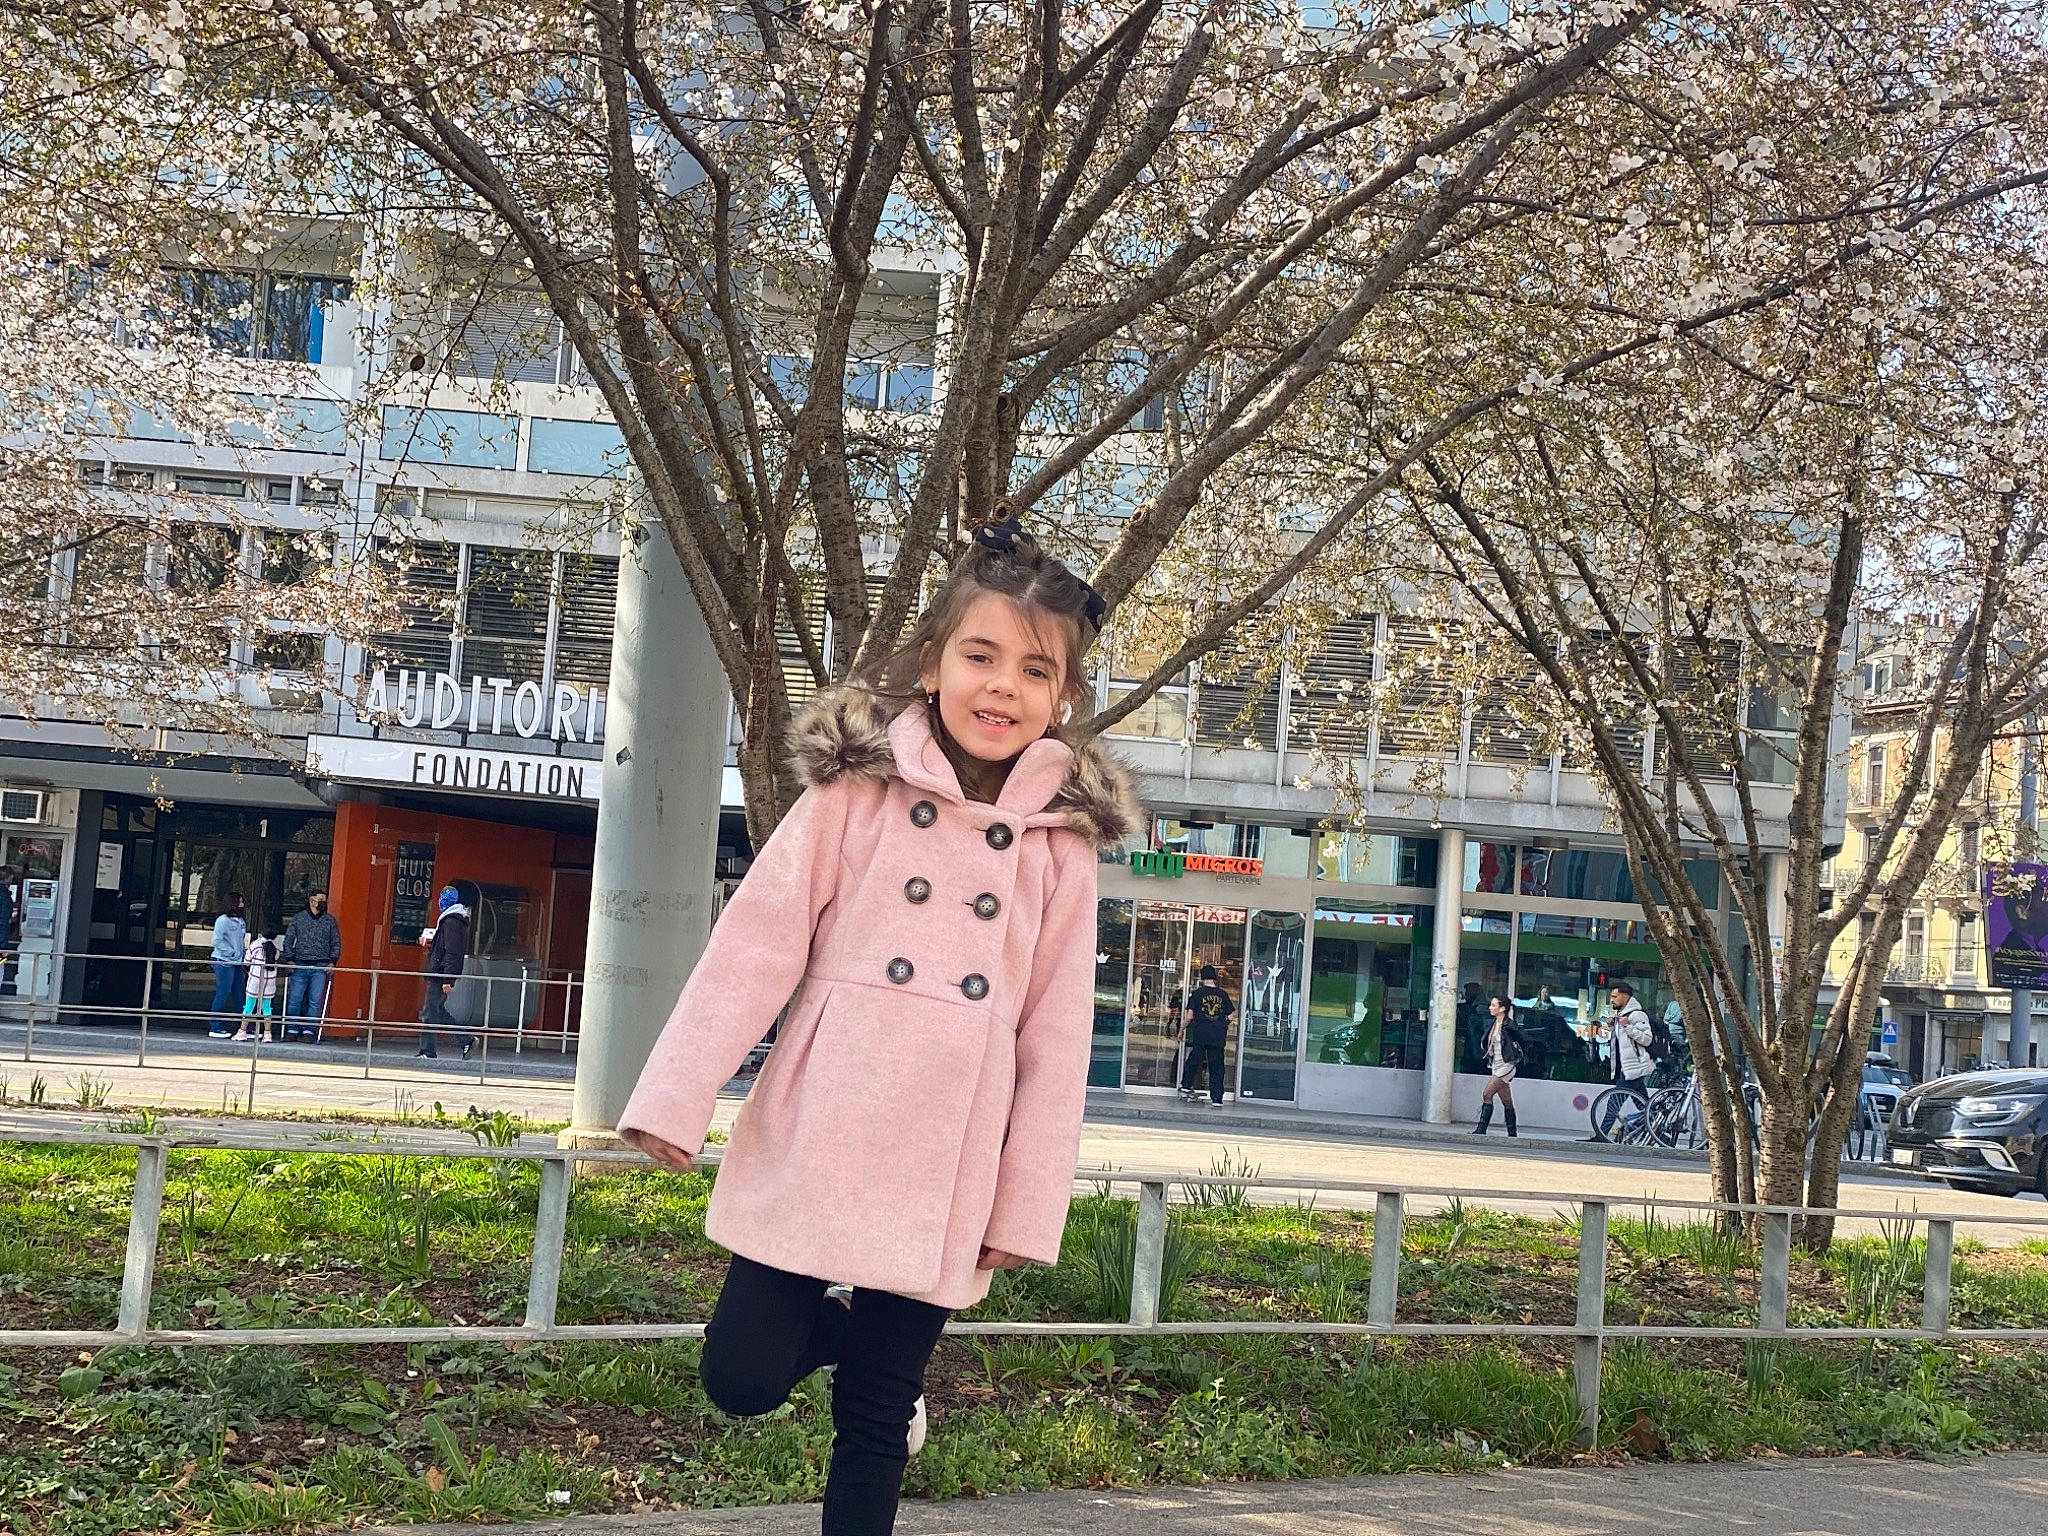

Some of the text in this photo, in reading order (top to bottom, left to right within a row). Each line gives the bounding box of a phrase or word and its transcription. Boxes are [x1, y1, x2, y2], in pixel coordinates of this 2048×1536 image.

[357, 667, 606, 743] AUDITORI
[412, 752, 584, 798] FONDATION
[260, 819, 268, 838] 1
[398, 858, 434, 879] HUIS
[1185, 855, 1264, 876] MIGROS
[396, 878, 431, 898] CLOS
